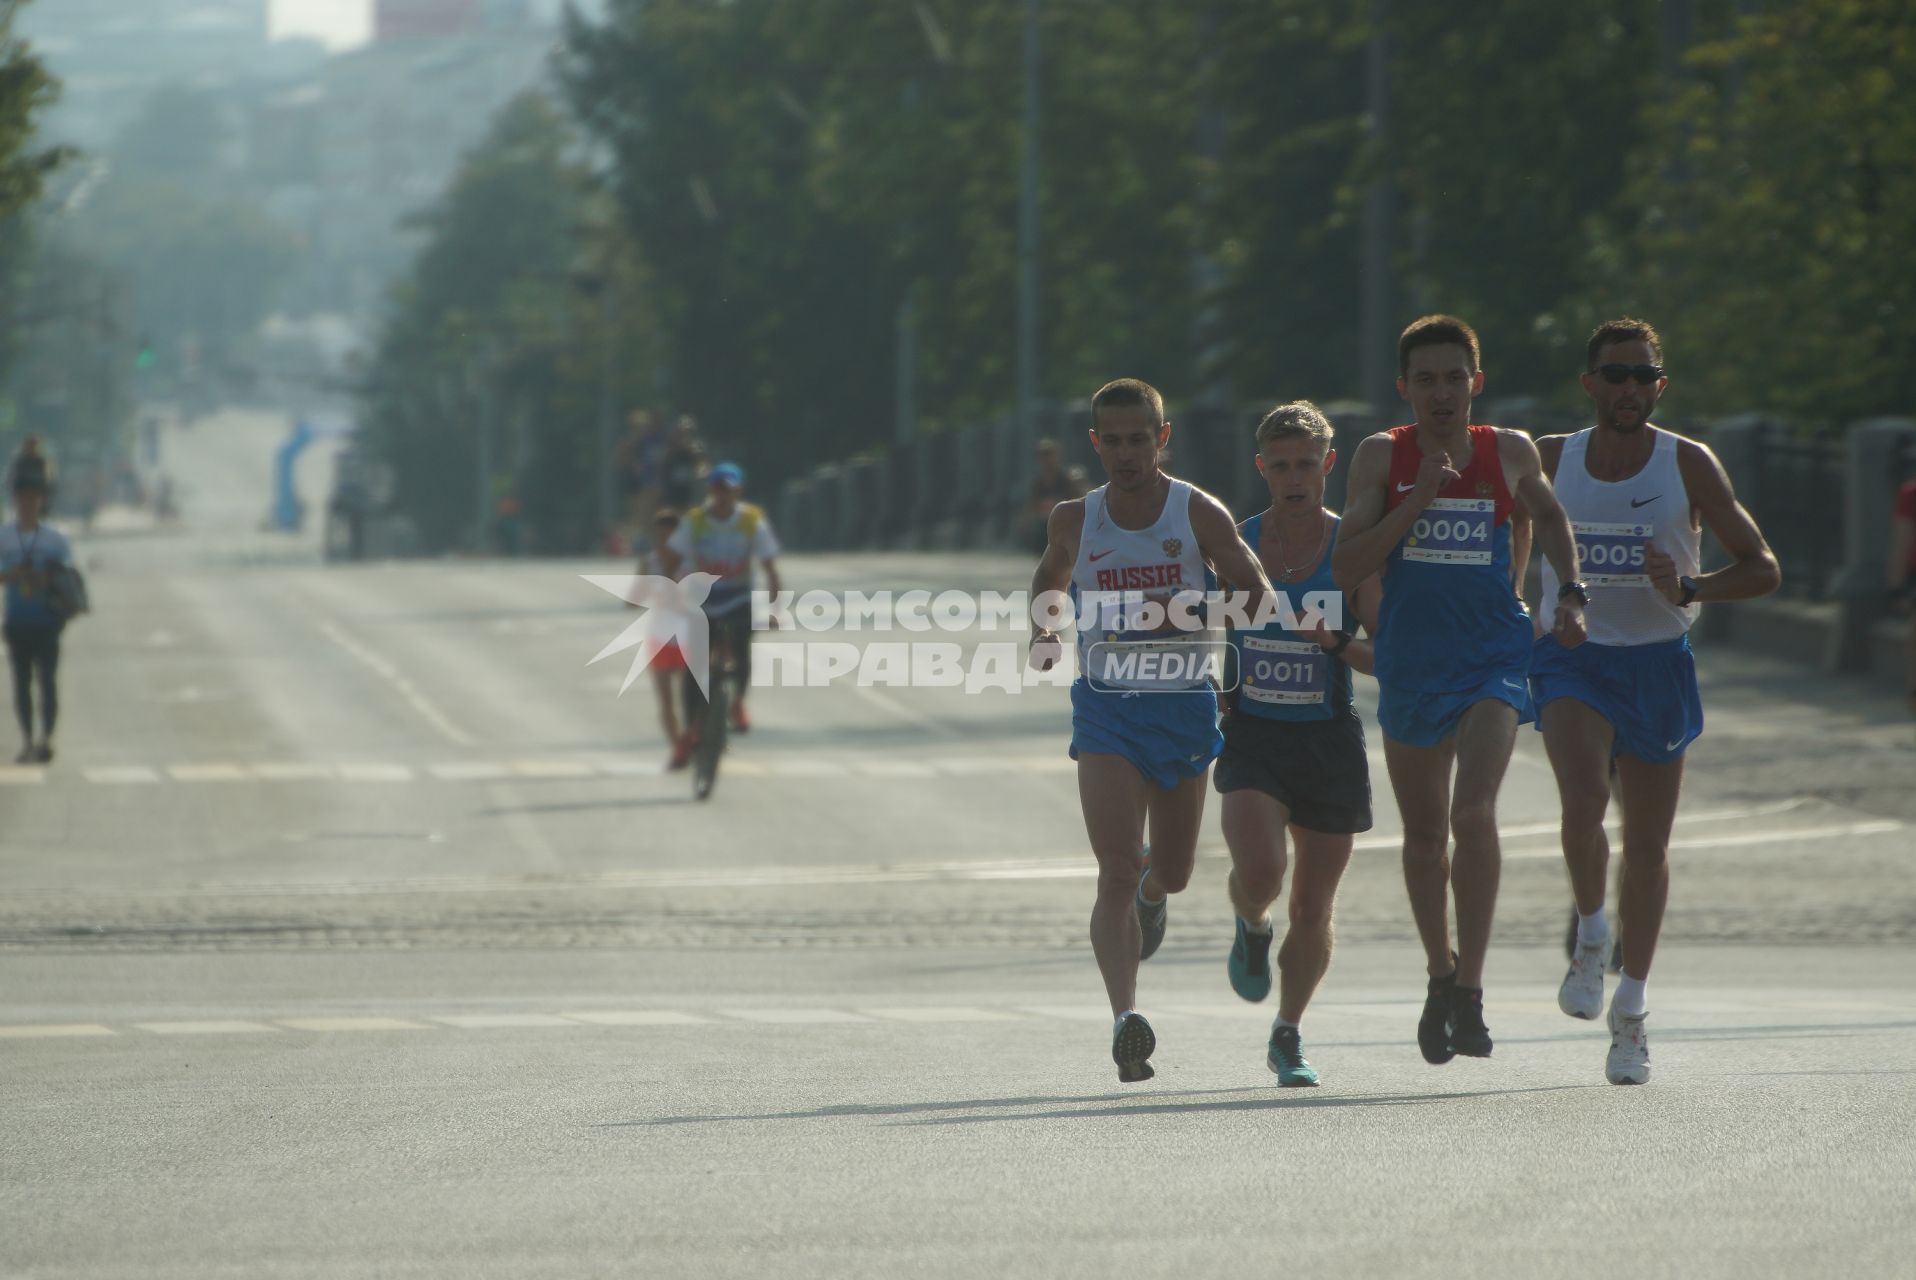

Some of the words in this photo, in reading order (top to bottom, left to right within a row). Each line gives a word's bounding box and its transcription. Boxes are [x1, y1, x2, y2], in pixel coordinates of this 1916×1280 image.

[1413, 518, 1488, 542] 0004
[1577, 543, 1645, 567] 0005
[1096, 564, 1183, 591] RUSSIA
[1255, 659, 1313, 684] 0011
